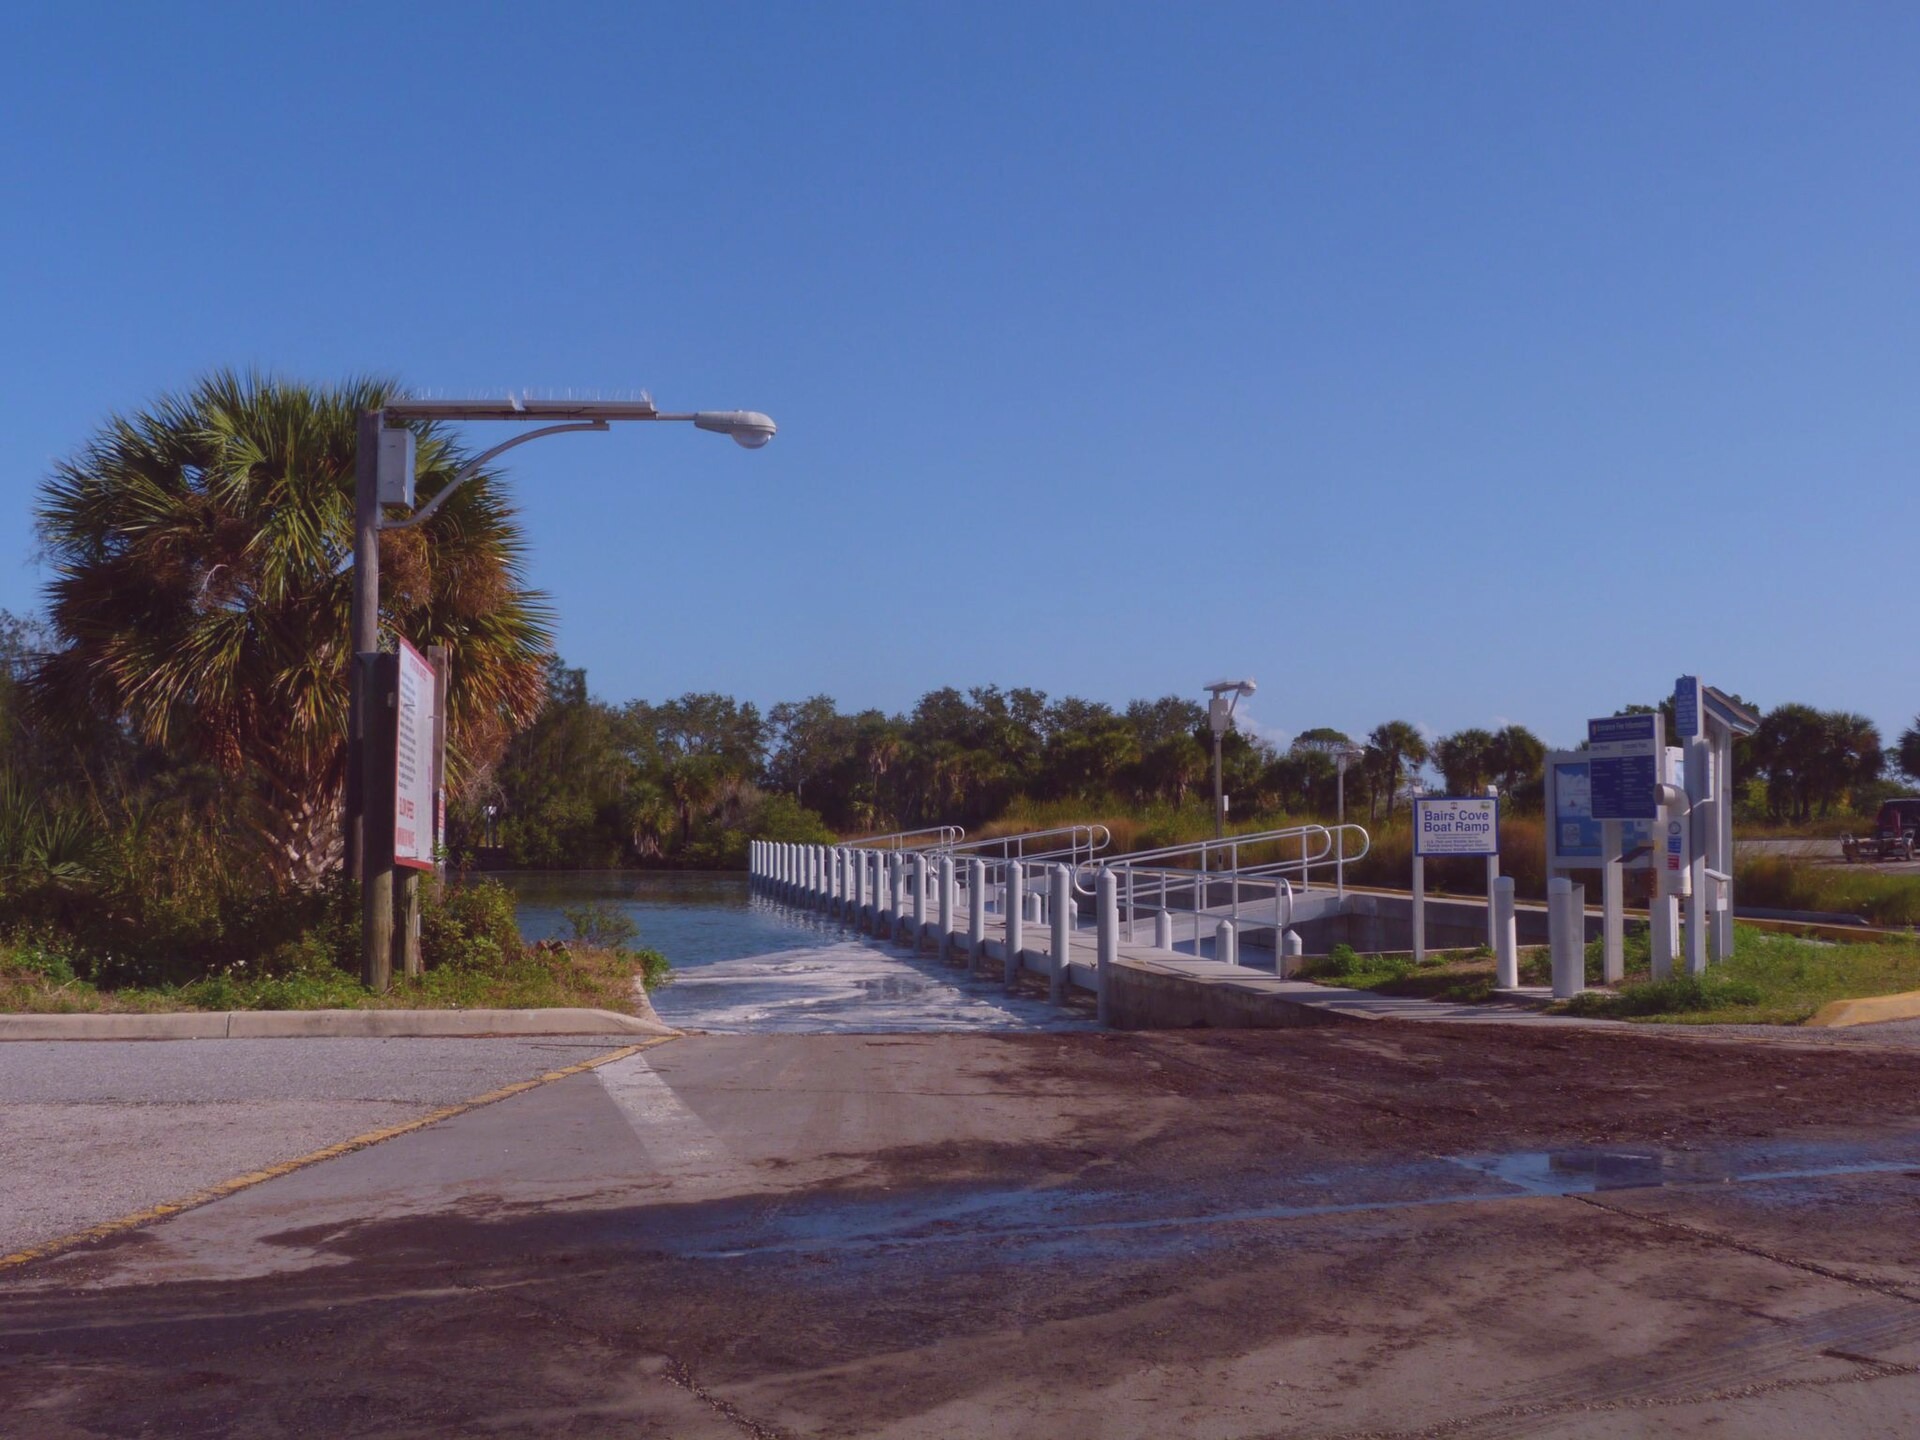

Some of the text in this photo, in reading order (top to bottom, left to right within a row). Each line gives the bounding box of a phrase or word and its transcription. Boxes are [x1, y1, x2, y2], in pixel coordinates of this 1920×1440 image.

[1424, 810, 1489, 821] Bairs Cove
[1424, 822, 1490, 834] Boat Ramp
